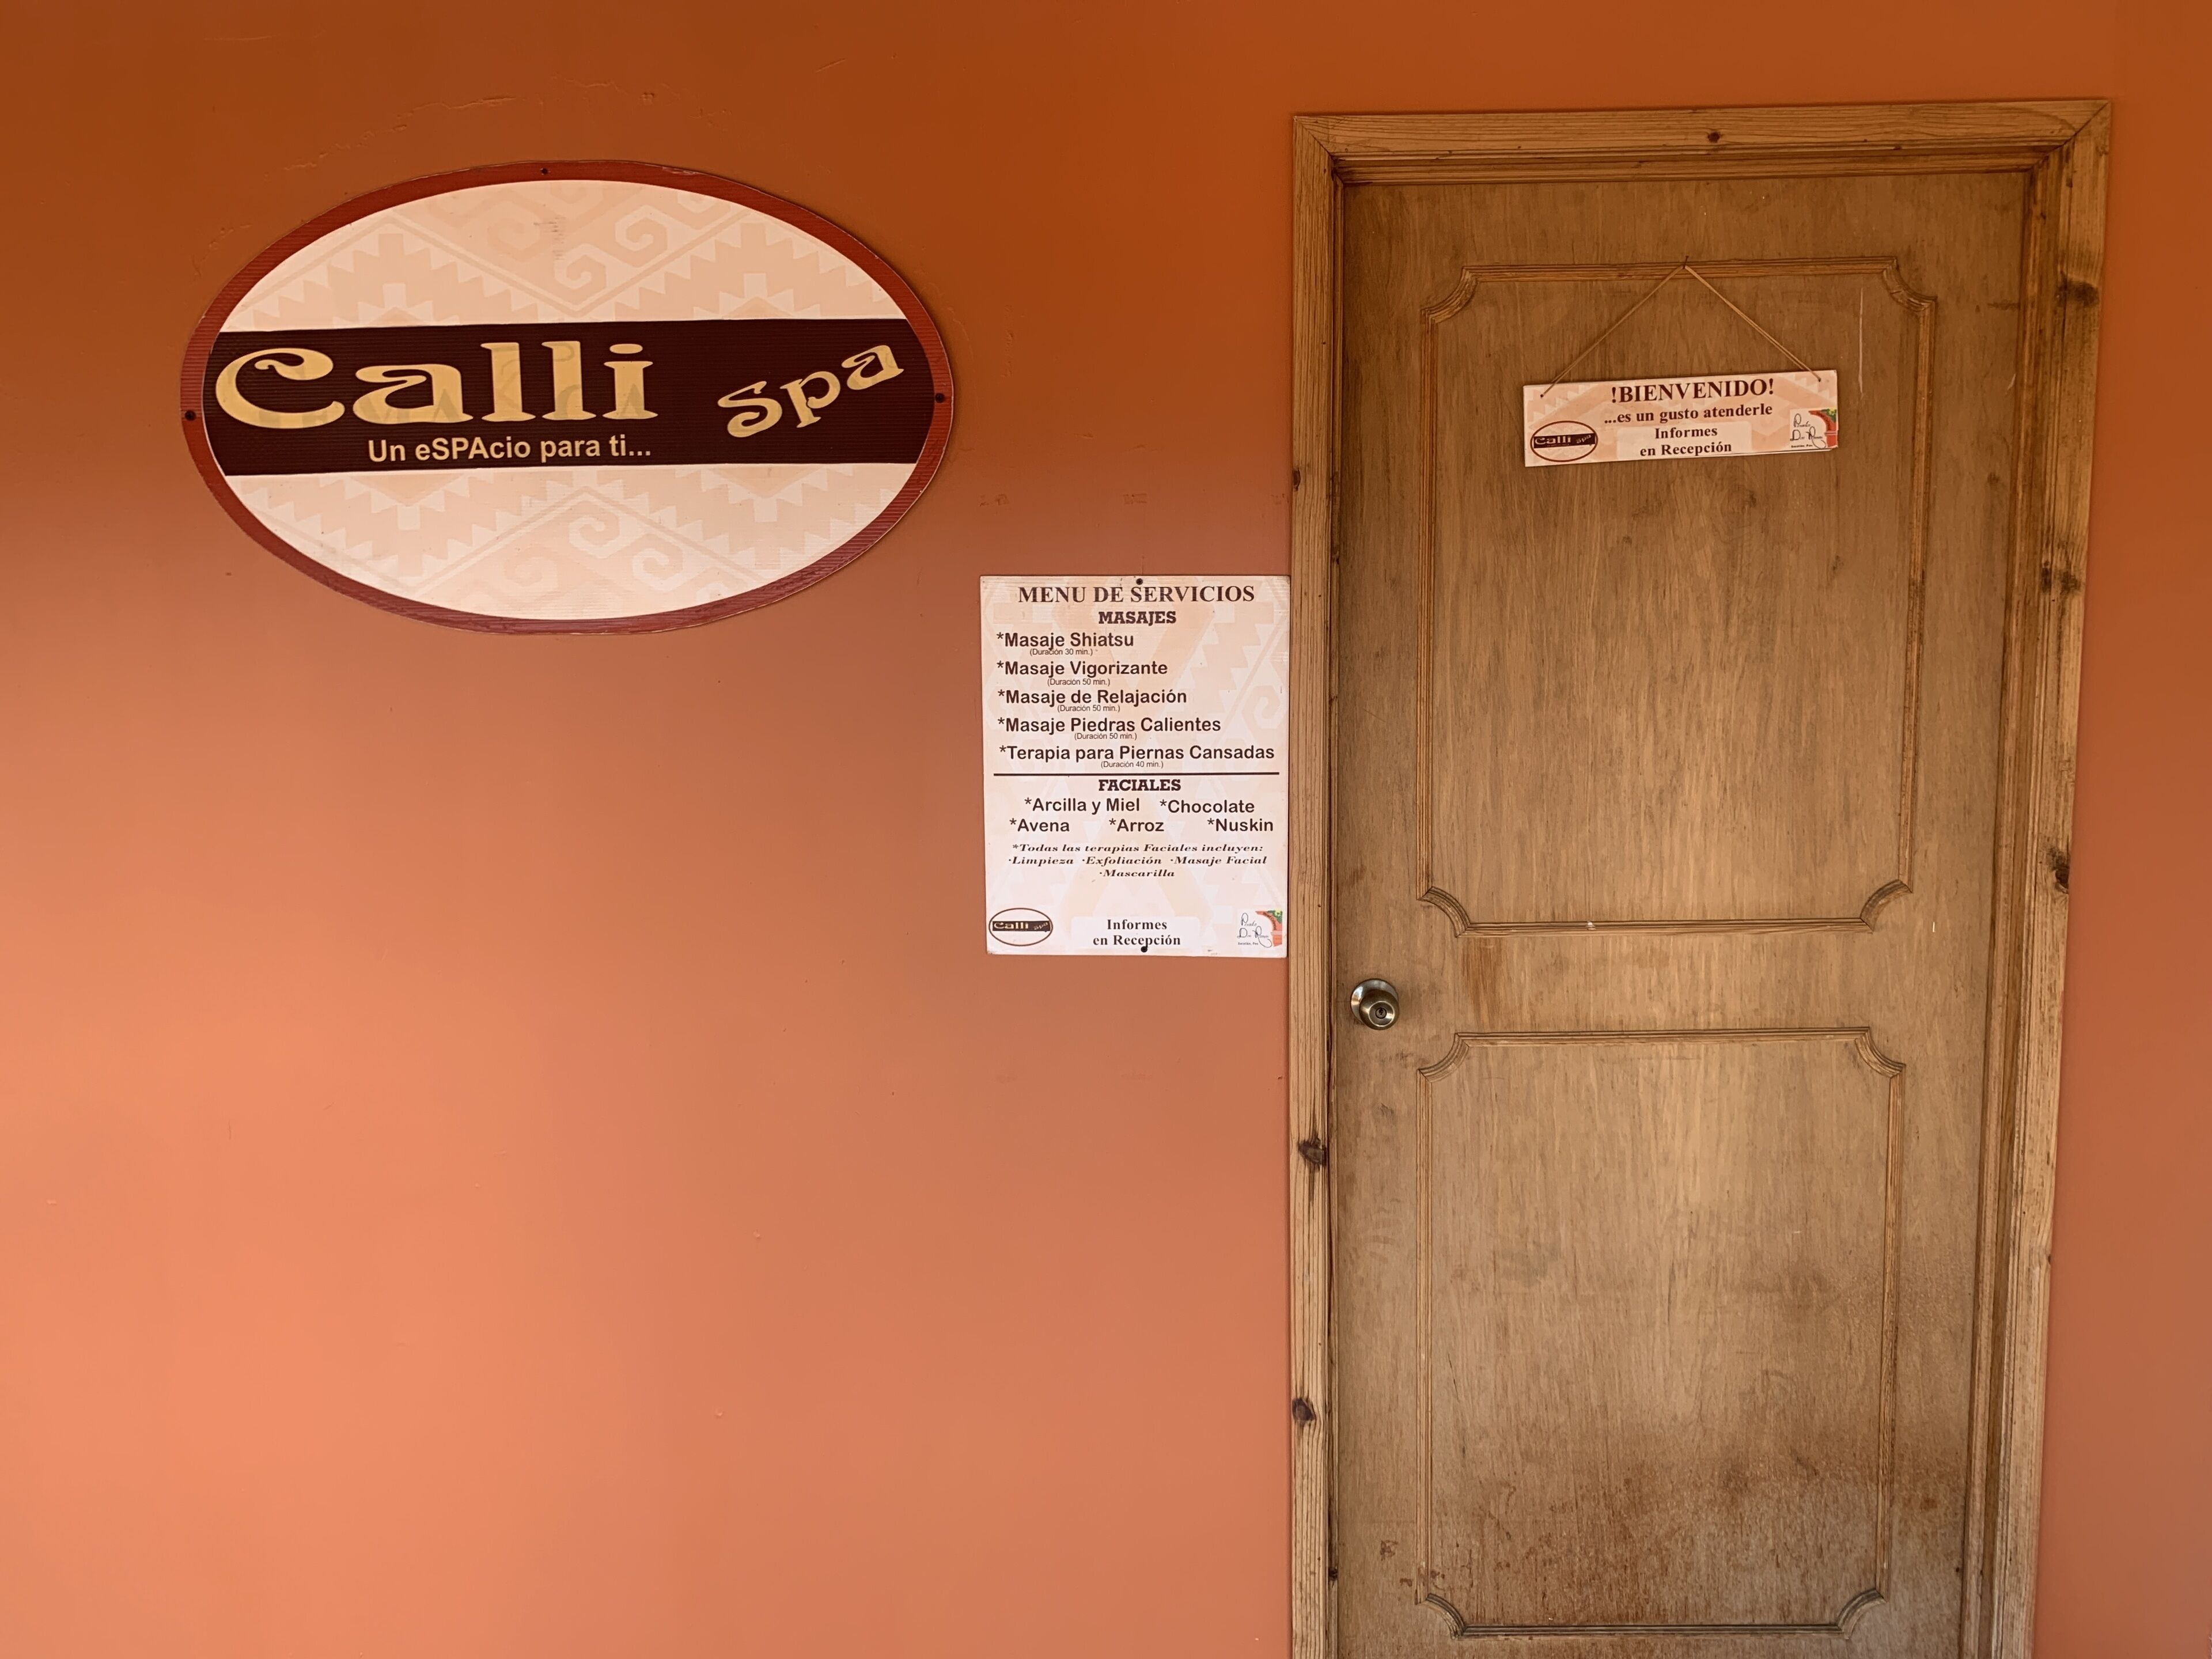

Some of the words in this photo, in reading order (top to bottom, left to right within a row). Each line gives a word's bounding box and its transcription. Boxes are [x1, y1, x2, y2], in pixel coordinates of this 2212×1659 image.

[215, 340, 658, 429] Calli
[1612, 378, 1774, 404] !BIENVENIDO!
[1604, 414, 1631, 424] ...es
[1636, 412, 1654, 422] un
[1659, 408, 1699, 424] gusto
[1703, 403, 1772, 418] atenderle
[1535, 435, 1571, 445] Calli
[1655, 427, 1718, 439] Informes
[367, 439, 406, 462] Un
[414, 437, 531, 461] eSPAcio
[540, 437, 601, 463] para
[609, 434, 652, 459] ti...
[1640, 448, 1656, 456] en
[1661, 441, 1732, 460] Recepción
[1018, 586, 1086, 603] MENU
[1094, 586, 1124, 603] DE
[1130, 585, 1255, 603] SERVICIOS
[1098, 611, 1177, 627] MASAJES
[1070, 631, 1134, 647] Shiatsu
[1029, 648, 1063, 656] (Duración
[1075, 648, 1093, 657] min.)
[1069, 660, 1168, 679] Vigorizante
[1047, 679, 1081, 687] (Duración
[1093, 678, 1111, 687] min.)
[1070, 689, 1092, 704] de
[1097, 688, 1187, 707] Relajación
[1057, 704, 1091, 713] (Duración
[1092, 704, 1101, 712] 50
[1103, 704, 1120, 713] min.)
[1071, 717, 1135, 732] Piedras
[1141, 717, 1221, 732] Calientes
[1074, 732, 1108, 741] (Duración
[1119, 732, 1137, 741] min.)
[1075, 748, 1114, 763] para
[1119, 745, 1184, 760] Piernas
[1189, 744, 1275, 759] Cansadas
[1100, 760, 1134, 769] (Duración
[1146, 760, 1164, 769] min.)
[1098, 778, 1181, 791] FACIALES
[1091, 801, 1101, 816] y
[1106, 797, 1140, 812] Miel
[1062, 844, 1081, 852] las
[1085, 844, 1139, 854] terapias
[1143, 843, 1198, 852] Faciales
[1202, 843, 1263, 854] incluyen:
[1225, 855, 1267, 864] Facial
[1107, 919, 1168, 930] Informes
[1093, 937, 1108, 946] en
[1113, 934, 1181, 948] Recepción
